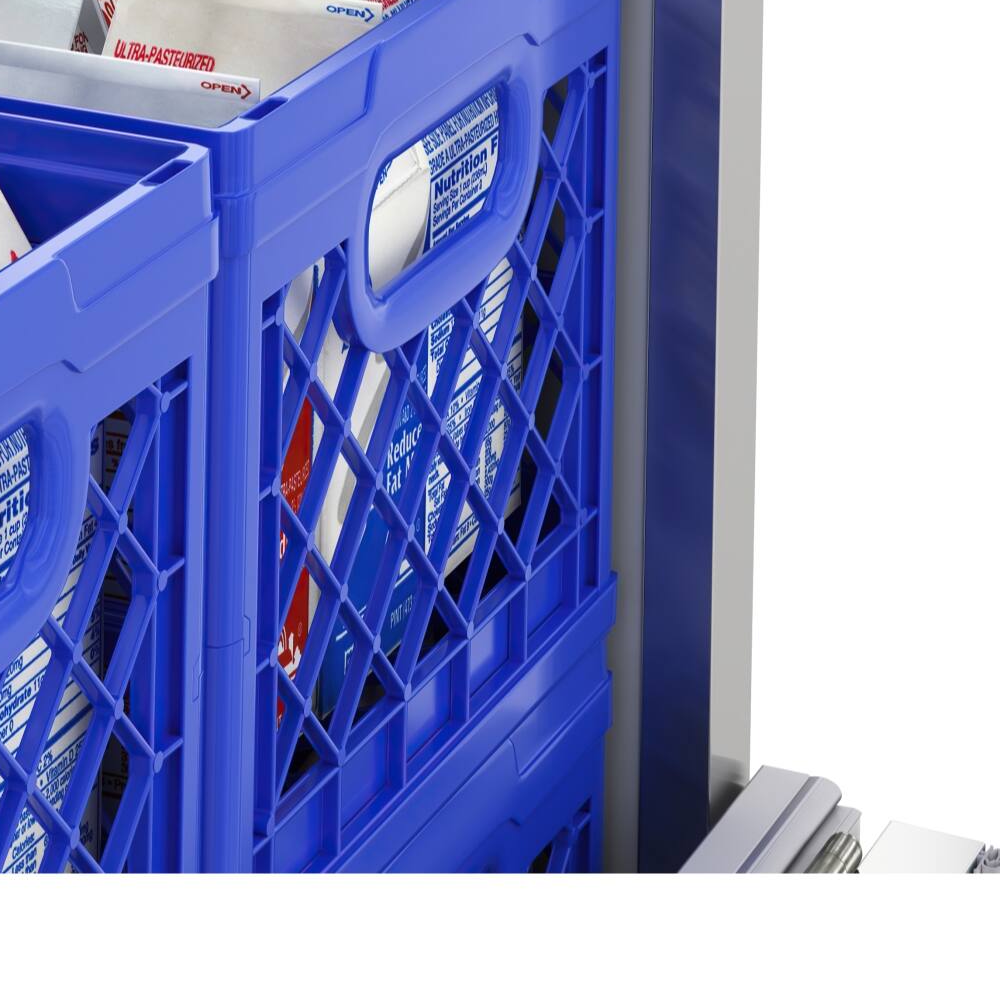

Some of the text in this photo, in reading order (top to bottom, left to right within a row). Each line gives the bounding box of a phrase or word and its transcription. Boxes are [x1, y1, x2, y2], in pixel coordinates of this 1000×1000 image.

[326, 5, 365, 18] OPEN
[114, 39, 215, 72] ULTRA-PASTEURIZED
[200, 80, 242, 96] OPEN
[435, 148, 487, 200] Nutrition
[386, 465, 402, 496] Fat
[9, 520, 20, 535] cup
